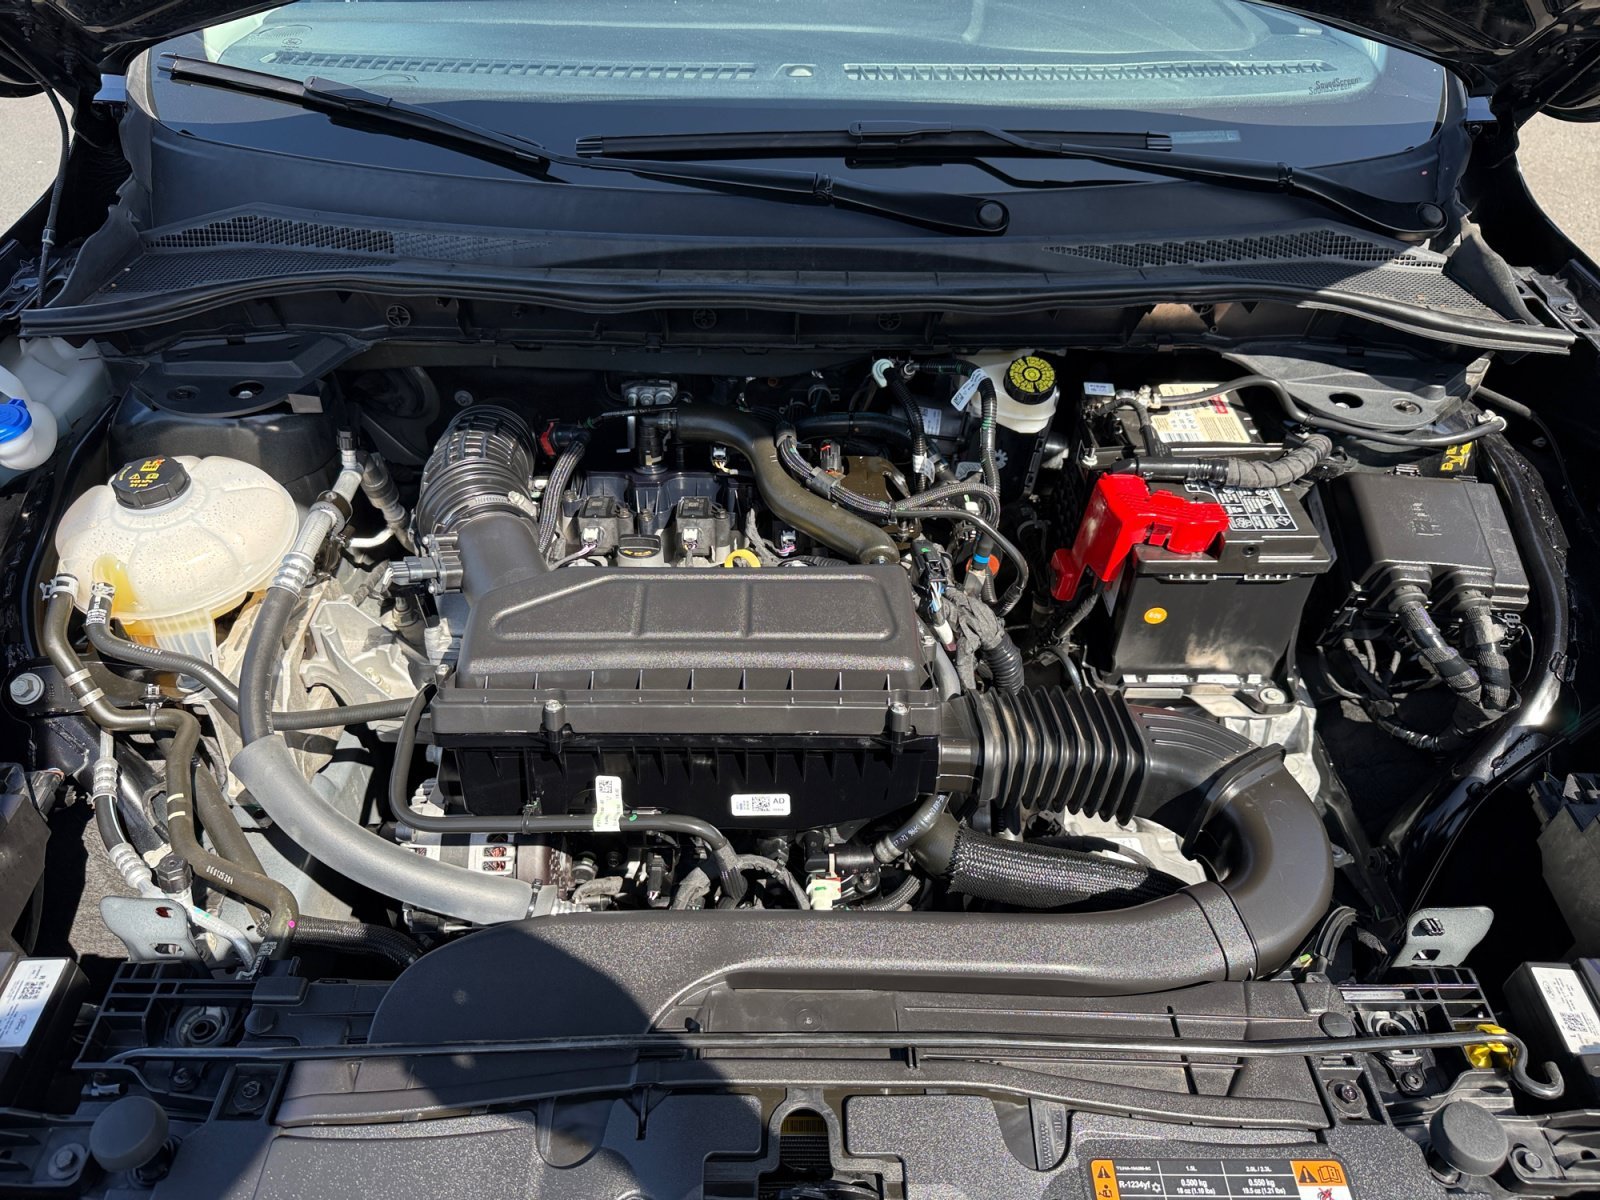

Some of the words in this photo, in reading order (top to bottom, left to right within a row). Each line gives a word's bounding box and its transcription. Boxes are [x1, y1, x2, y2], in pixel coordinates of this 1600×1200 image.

[772, 797, 786, 805] AD
[1118, 1180, 1151, 1190] R-1234yf
[1180, 1178, 1198, 1187] 0.500
[1197, 1178, 1208, 1188] kg
[1265, 1178, 1276, 1188] kg
